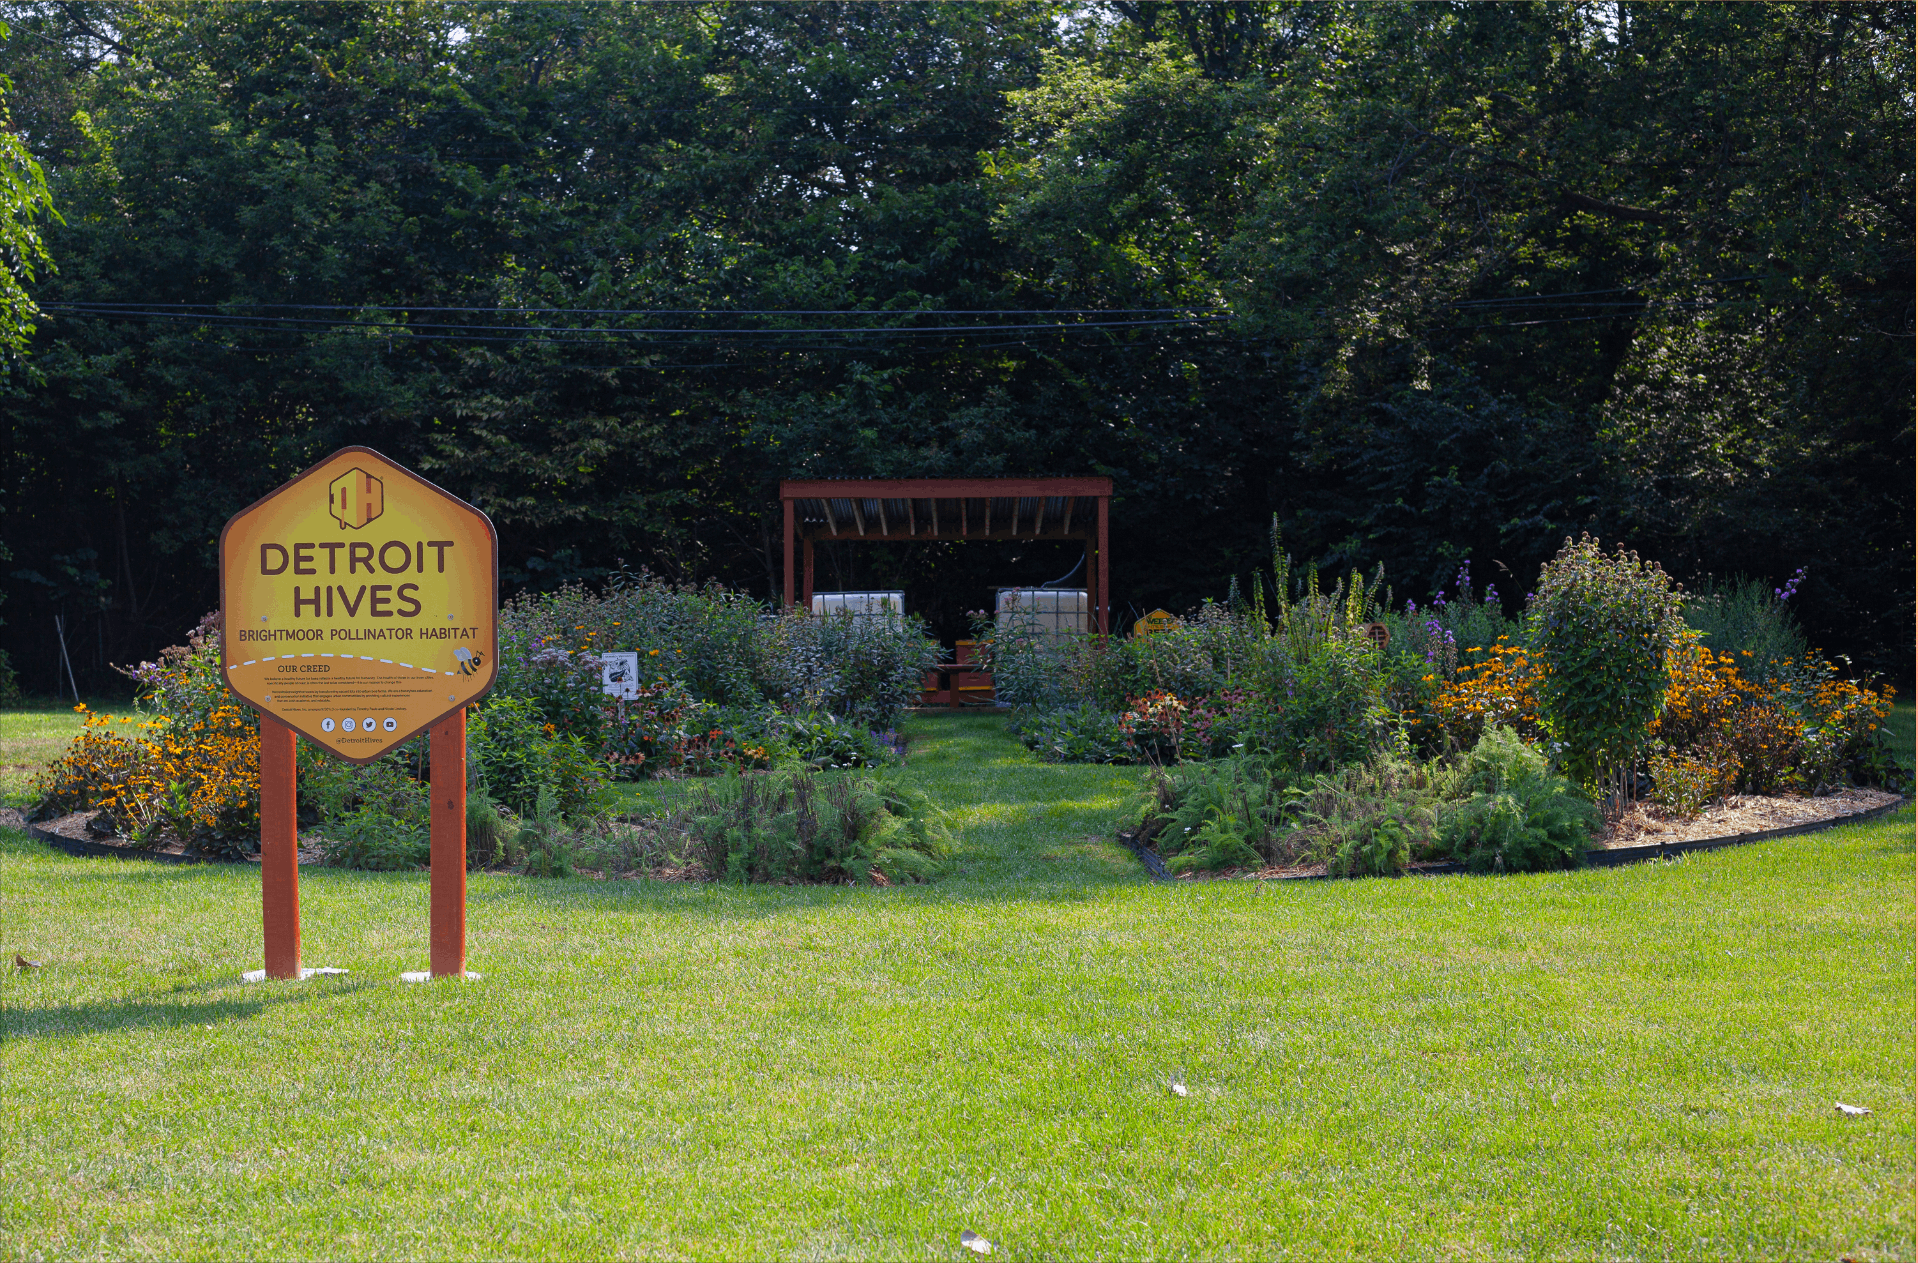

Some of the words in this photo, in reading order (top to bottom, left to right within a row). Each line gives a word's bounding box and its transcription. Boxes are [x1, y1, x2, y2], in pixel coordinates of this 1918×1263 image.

[260, 540, 455, 576] DETROIT
[293, 582, 422, 618] HIVES
[239, 628, 324, 642] BRIGHTMOOR
[330, 627, 413, 641] POLLINATOR
[419, 626, 479, 640] HABITAT
[277, 664, 298, 673] OUR
[299, 664, 331, 673] CREED
[335, 737, 384, 745] @DetroitHives
